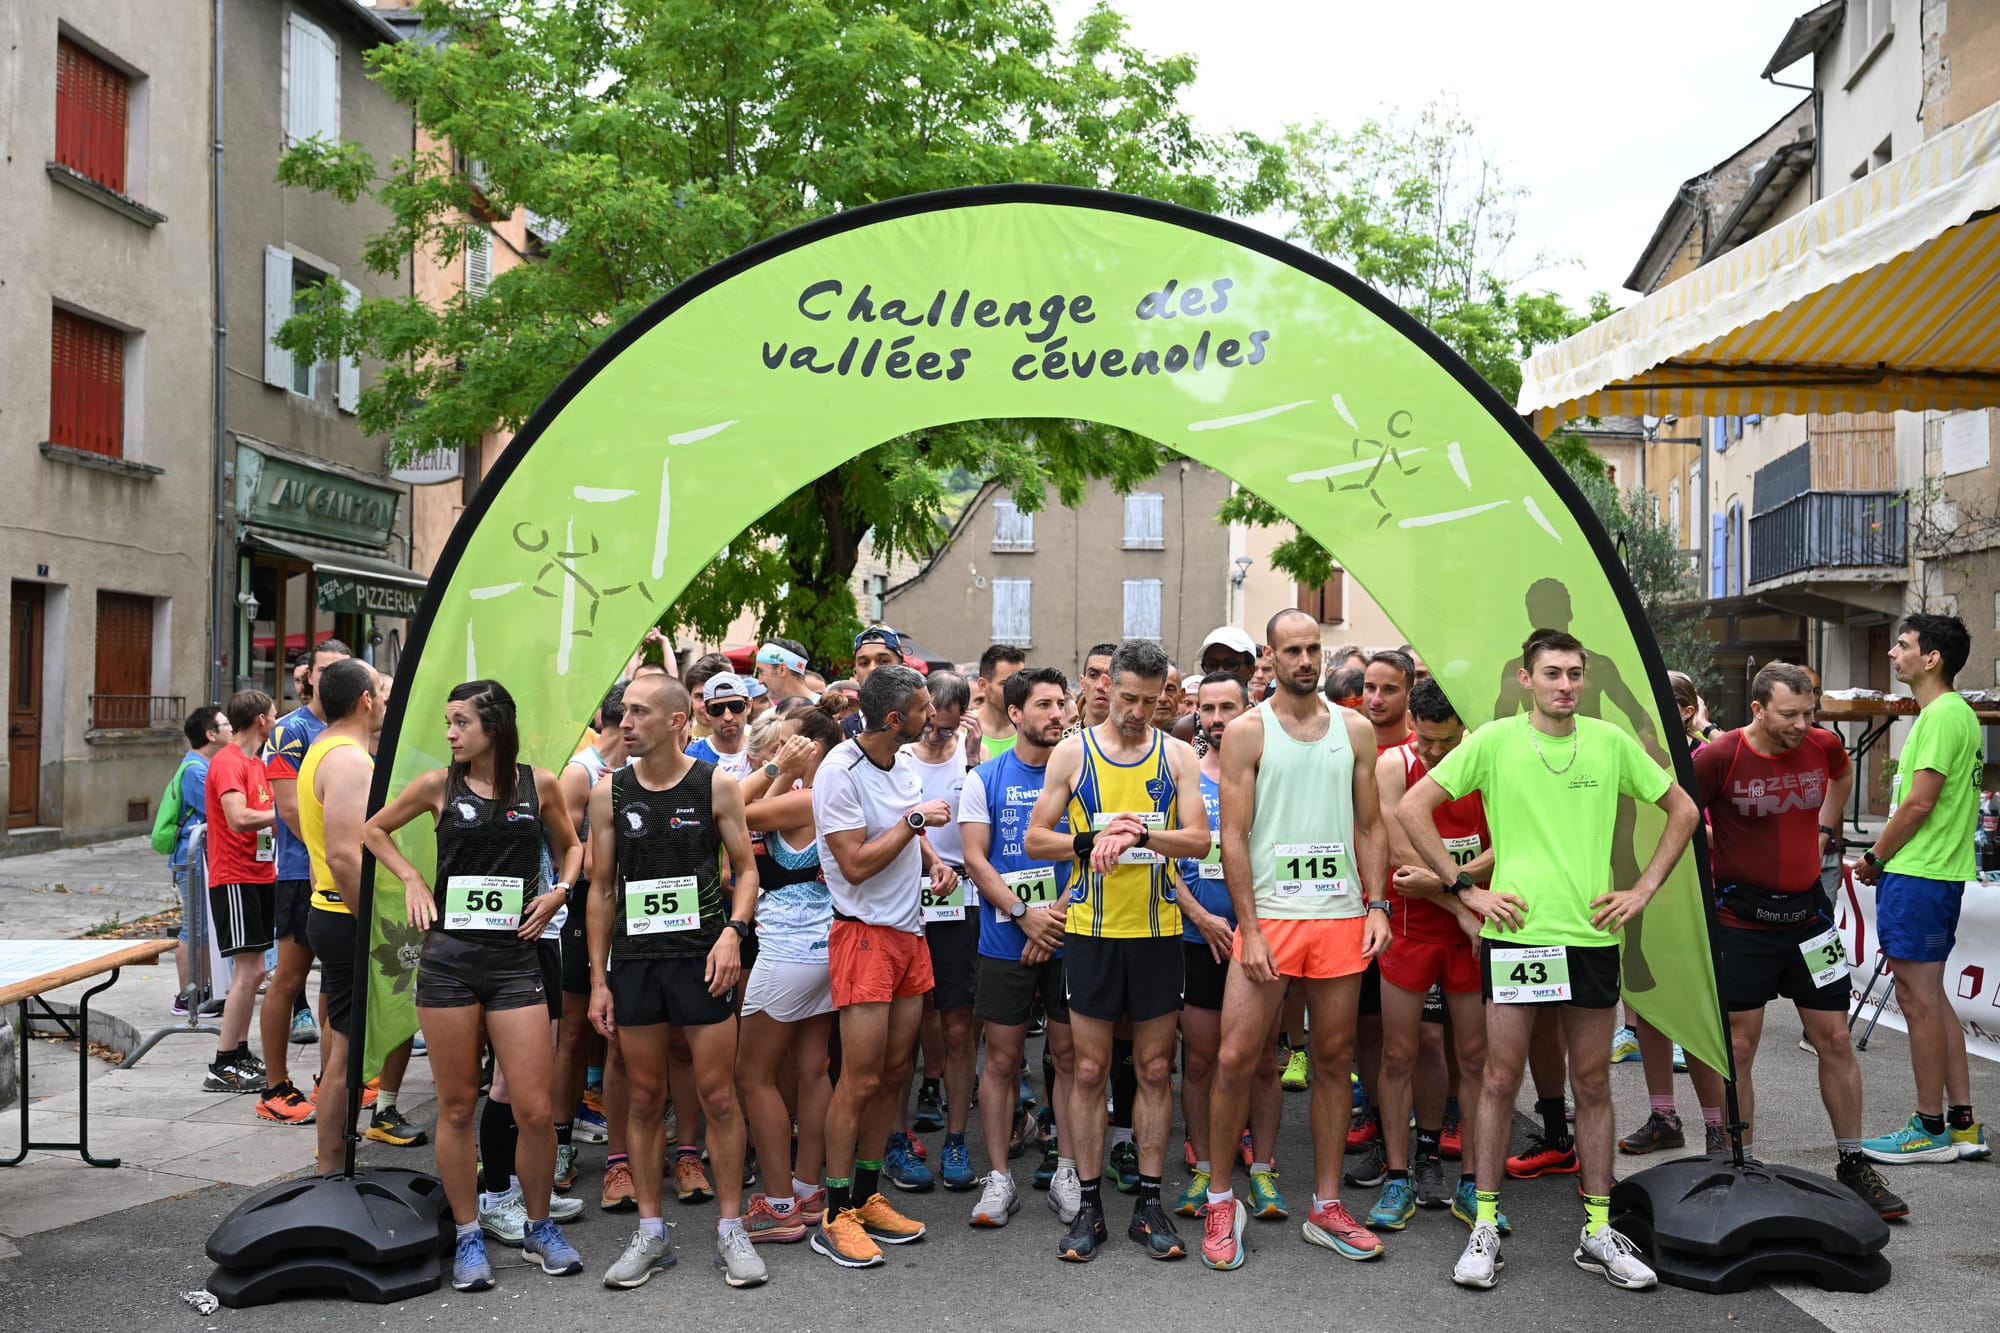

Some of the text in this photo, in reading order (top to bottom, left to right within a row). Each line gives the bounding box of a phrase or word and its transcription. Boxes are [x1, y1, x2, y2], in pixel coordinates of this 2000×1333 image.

[798, 278, 1234, 343] Challenge des
[762, 329, 1270, 381] vallées cévenoles
[269, 479, 307, 508] AU
[318, 579, 339, 596] PIZZA
[356, 584, 417, 614] PIZZERIA
[1287, 858, 1337, 879] 115
[466, 890, 503, 912] 56
[1008, 881, 1045, 902] 01
[644, 892, 679, 916] 55
[1756, 908, 1807, 921] MILLET
[1822, 937, 1845, 965] 35
[1510, 962, 1548, 985] 43
[1901, 1138, 1933, 1152] HOKA
